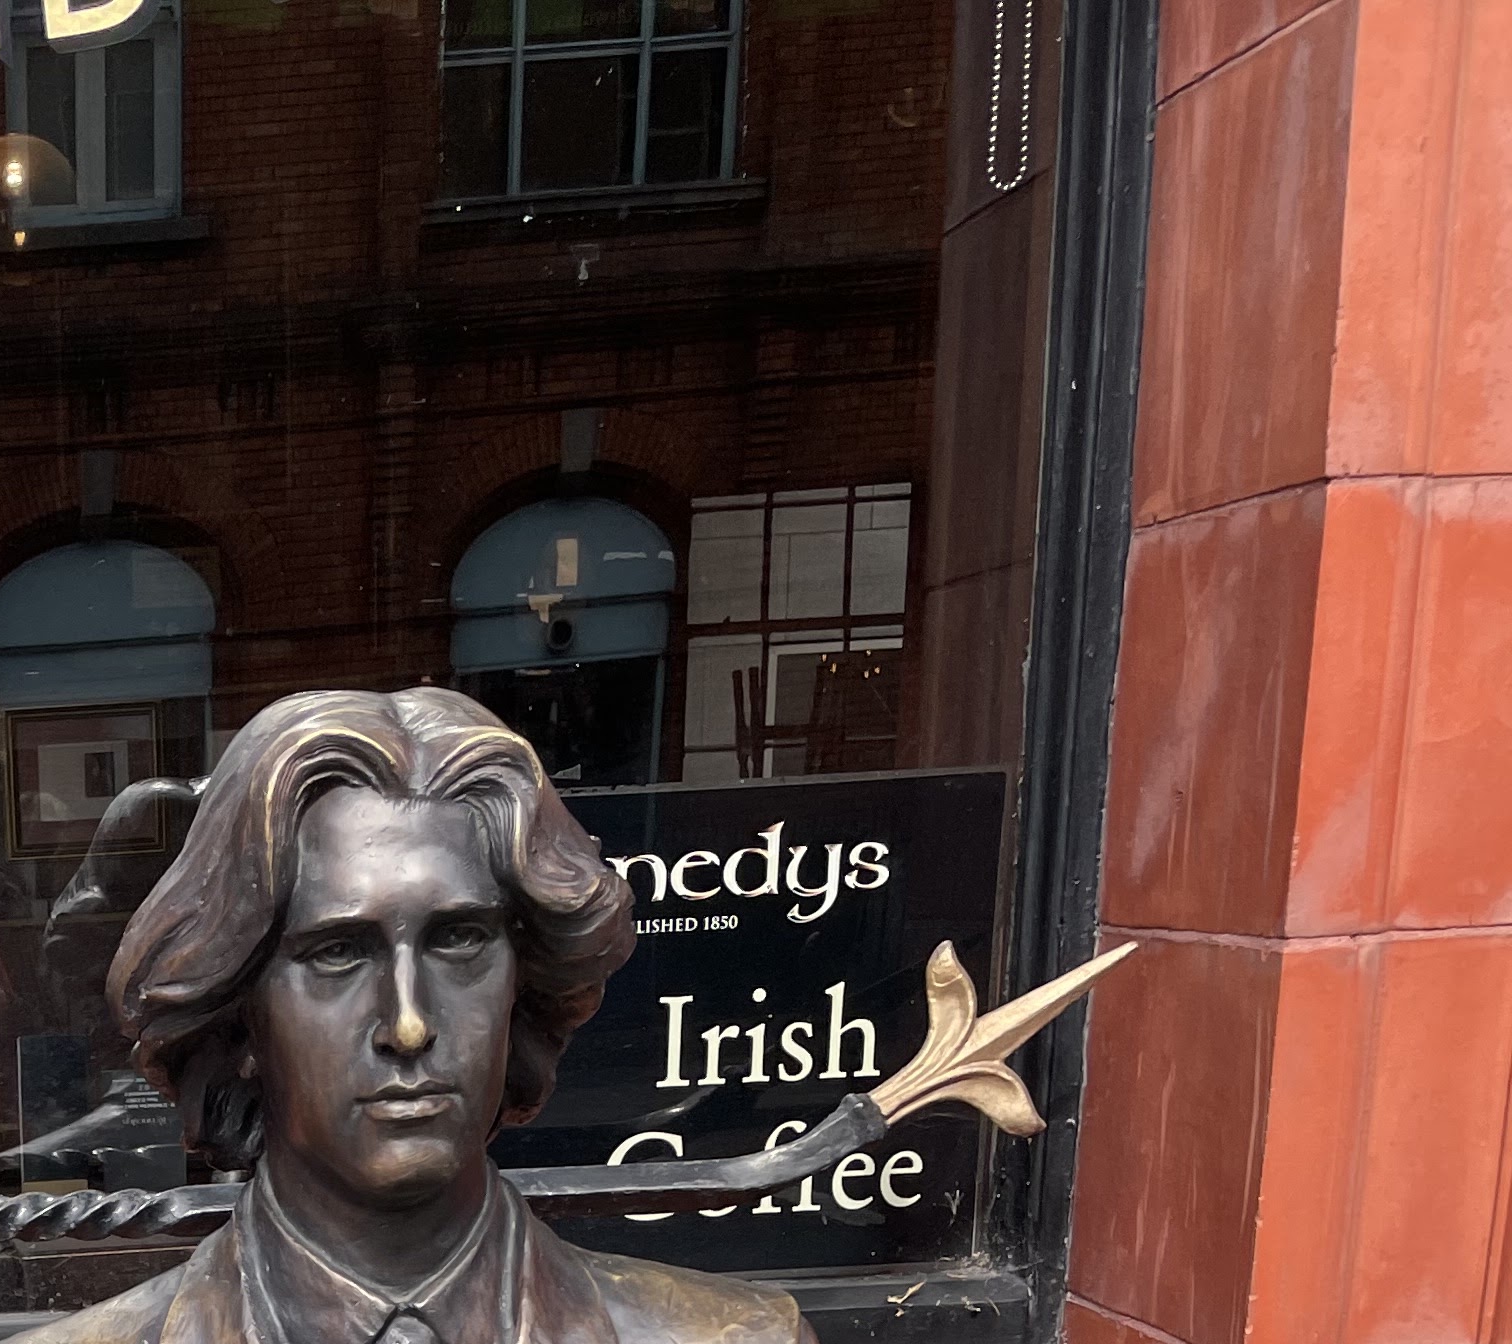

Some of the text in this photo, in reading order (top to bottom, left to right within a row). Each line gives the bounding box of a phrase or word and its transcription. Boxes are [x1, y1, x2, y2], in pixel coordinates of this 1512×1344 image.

[703, 914, 739, 931] 1850
[656, 981, 881, 1088] Irish
[606, 1120, 924, 1222] Cfee
